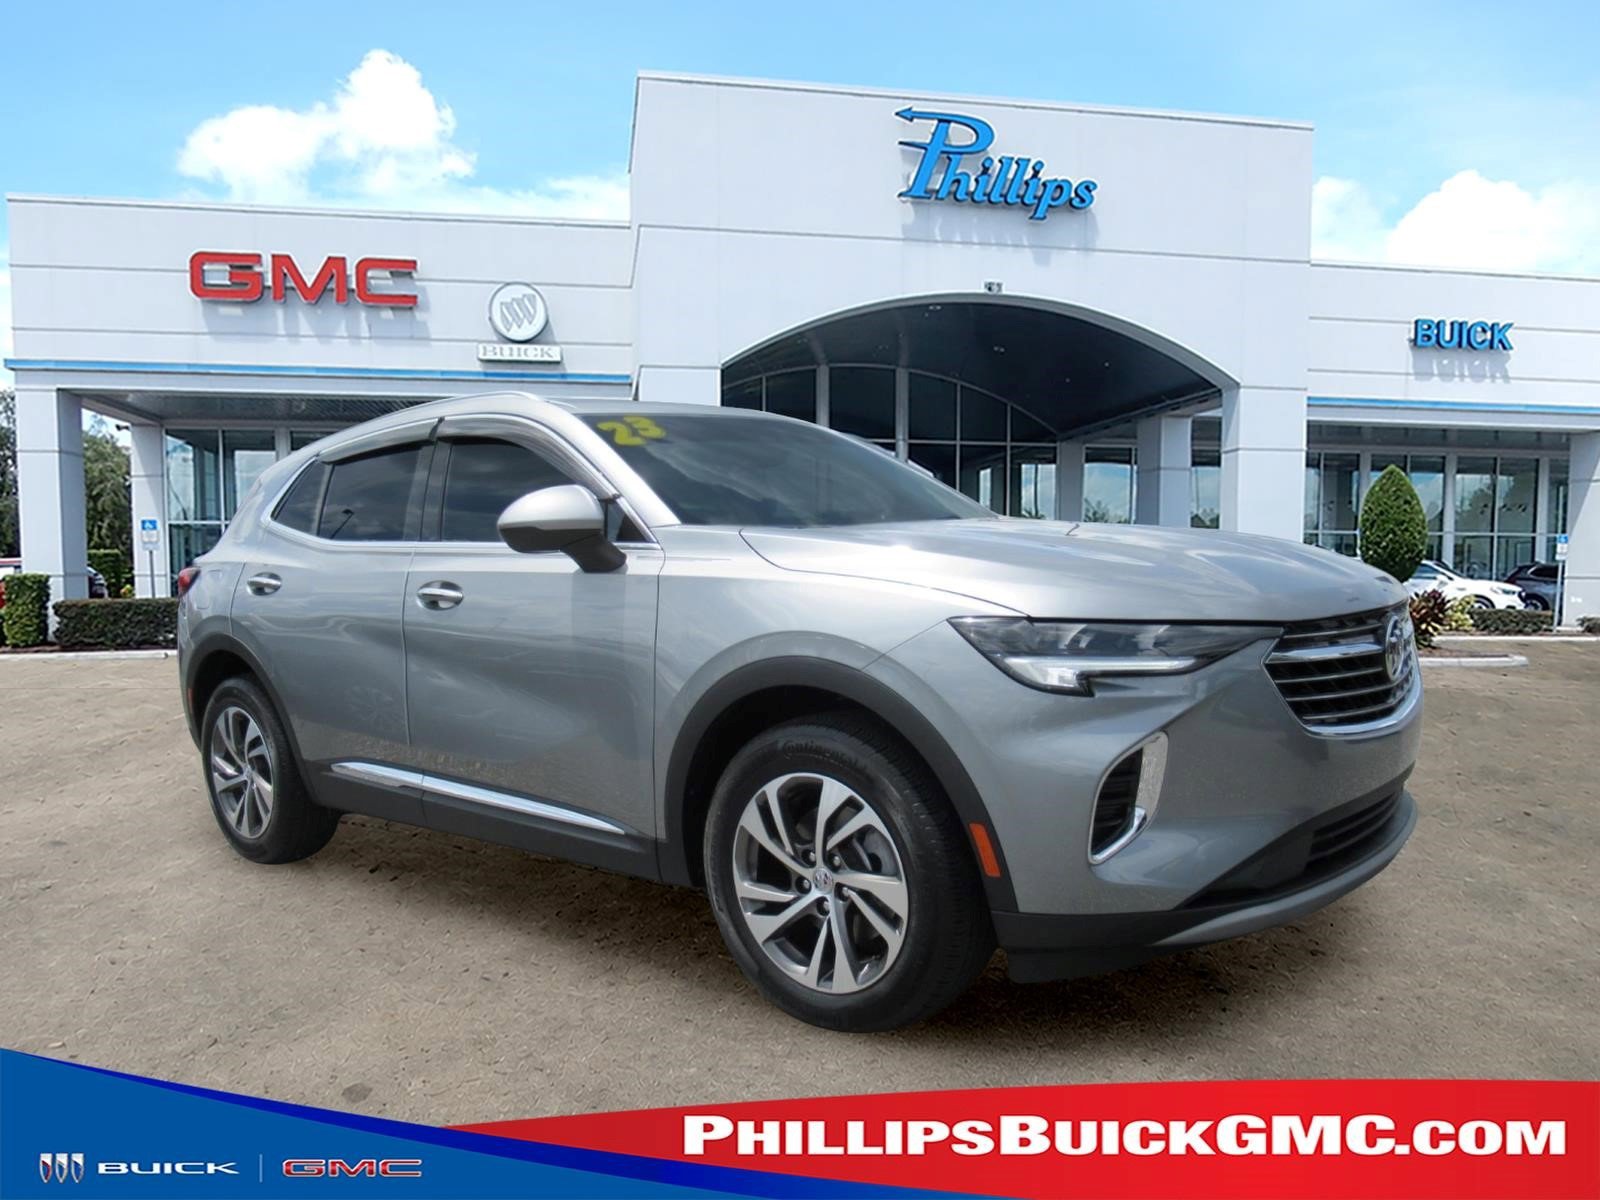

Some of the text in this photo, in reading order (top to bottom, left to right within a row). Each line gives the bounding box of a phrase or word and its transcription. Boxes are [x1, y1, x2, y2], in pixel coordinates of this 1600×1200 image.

[895, 107, 1098, 220] Phillips
[189, 251, 418, 307] GMC
[1414, 318, 1514, 350] BUICK
[481, 345, 555, 359] BUICK
[596, 415, 667, 446] 23
